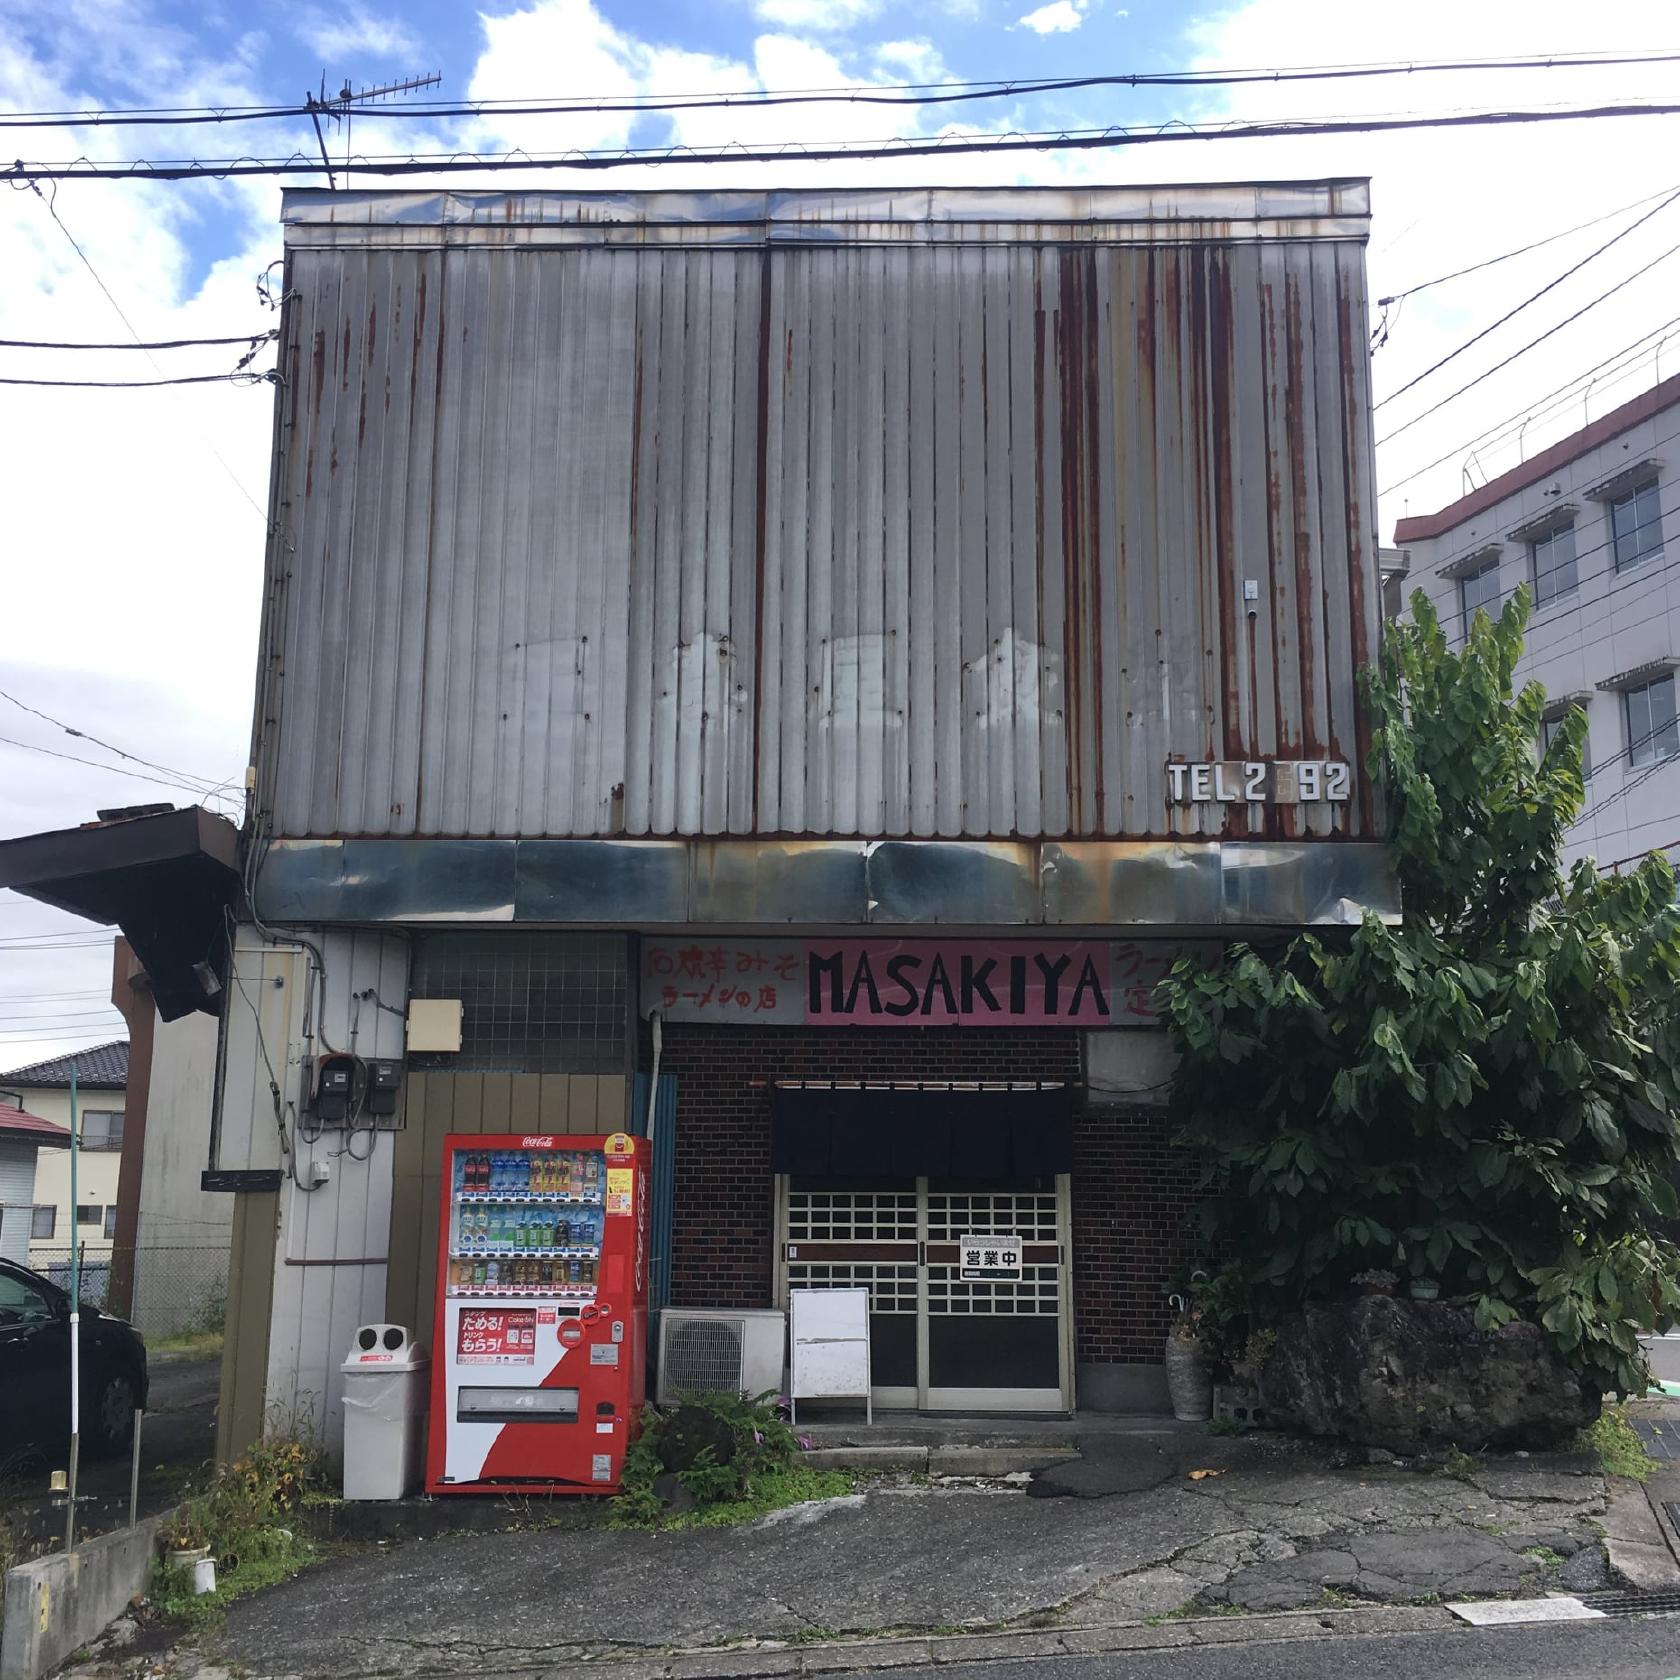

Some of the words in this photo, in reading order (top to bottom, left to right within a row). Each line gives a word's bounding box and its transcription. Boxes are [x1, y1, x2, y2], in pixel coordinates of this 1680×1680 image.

[1168, 762, 1235, 802] TEL
[808, 949, 1110, 1017] MASAKIYA
[966, 1250, 1017, 1267] 営業中
